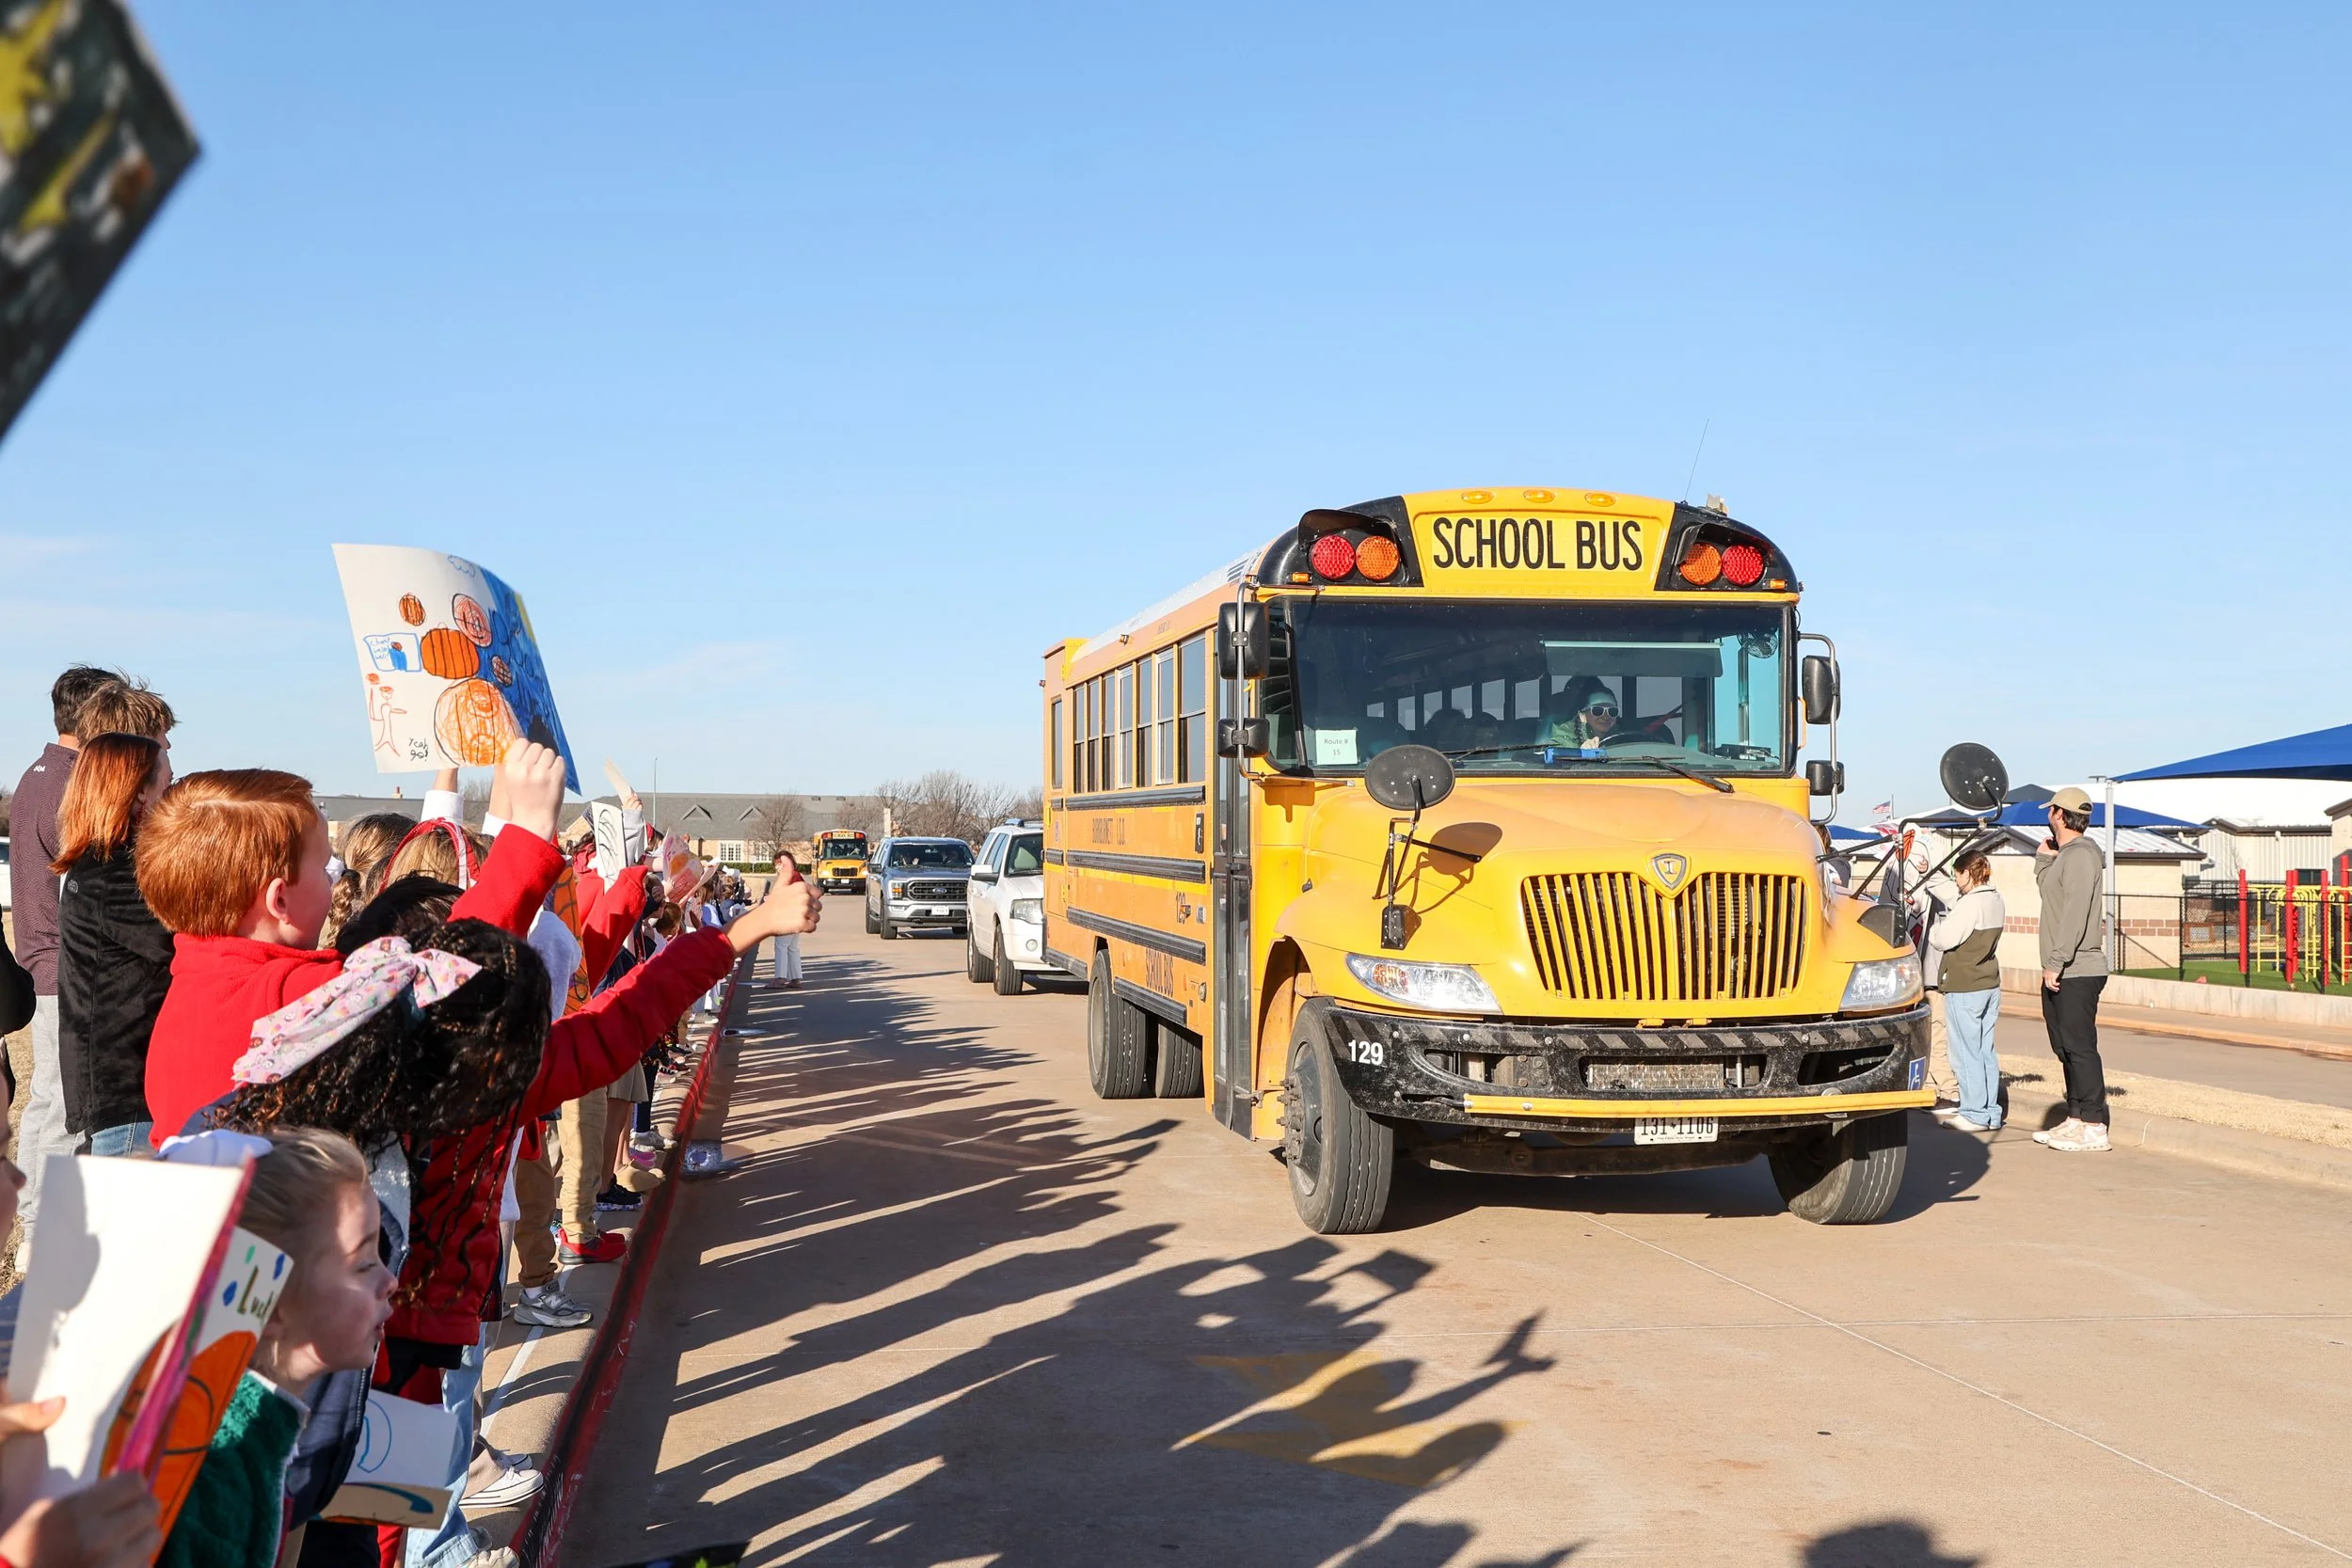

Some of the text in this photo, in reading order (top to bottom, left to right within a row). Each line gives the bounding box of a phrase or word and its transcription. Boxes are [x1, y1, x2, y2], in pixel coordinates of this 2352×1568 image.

[1433, 517, 1643, 571] SCHOOL BUS
[1348, 1039, 1383, 1066] 129
